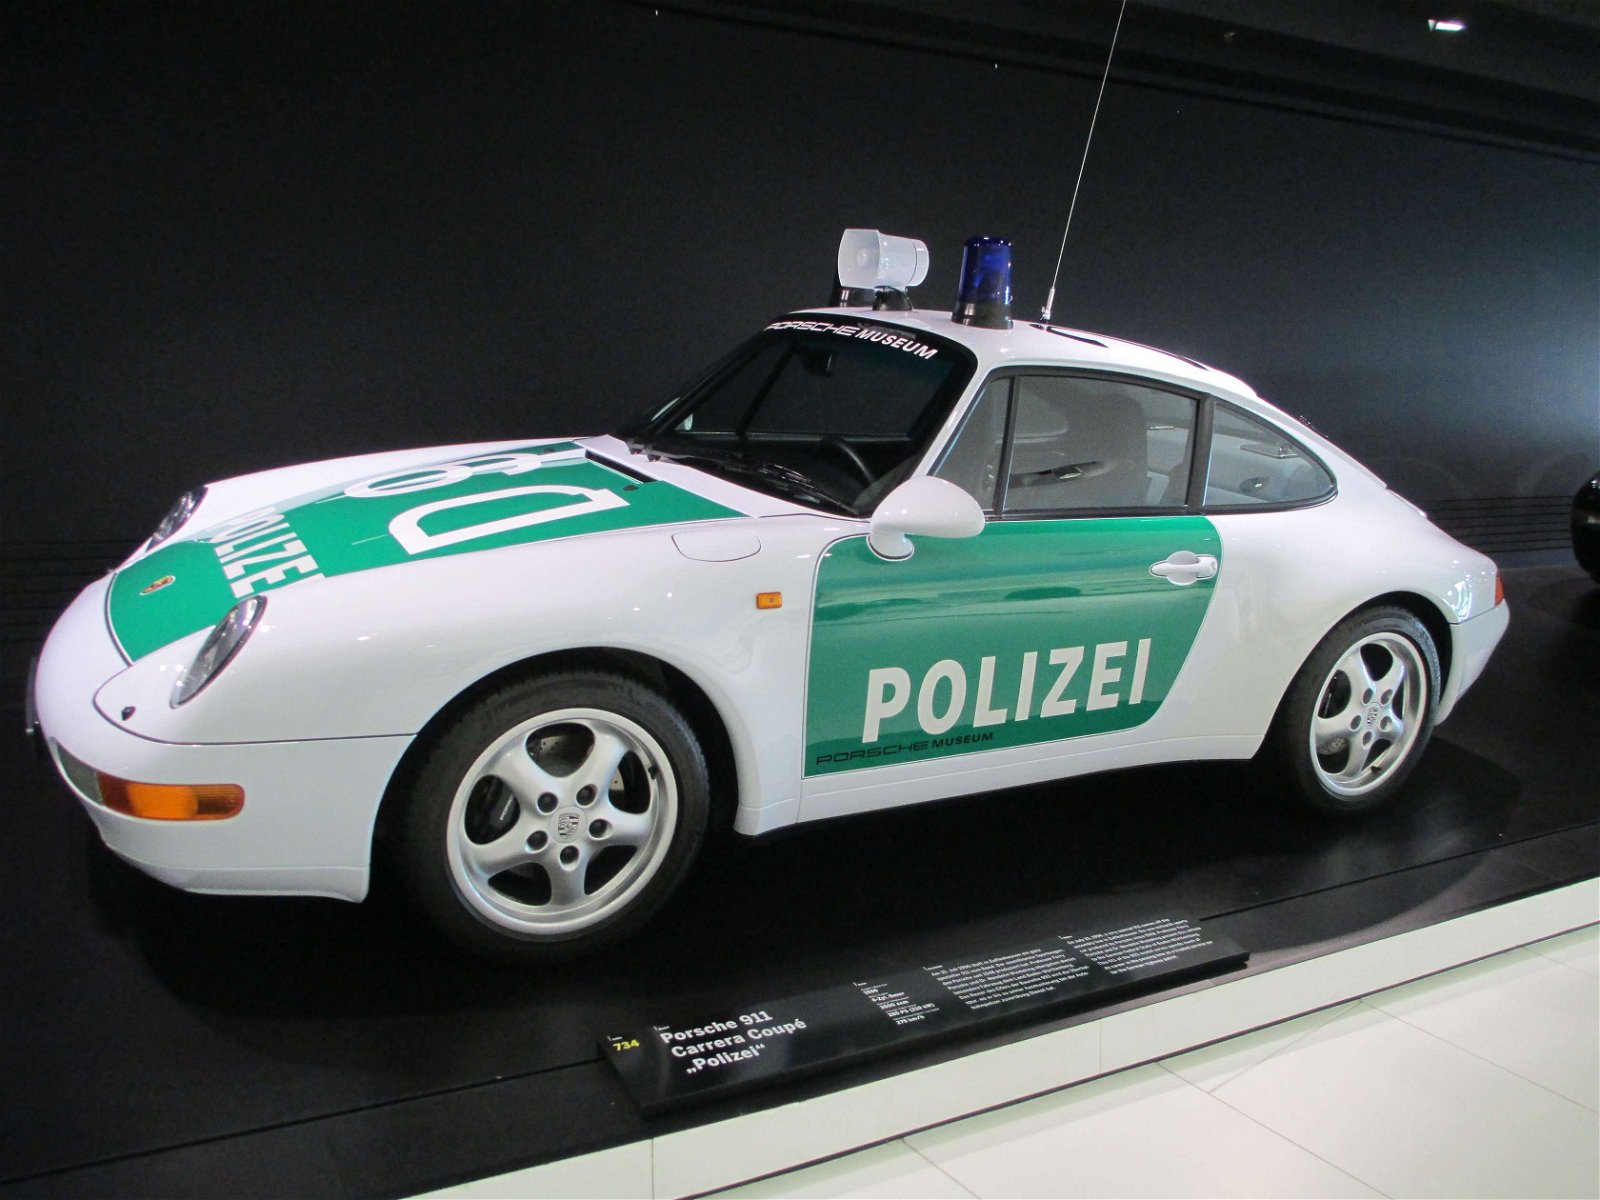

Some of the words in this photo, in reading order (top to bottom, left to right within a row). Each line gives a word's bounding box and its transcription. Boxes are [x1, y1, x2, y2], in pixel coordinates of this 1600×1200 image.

[763, 321, 861, 336] PORSCHE
[855, 329, 939, 360] MUSEUM
[862, 638, 1152, 744] POLIZEI
[815, 740, 929, 765] PORSCHE
[932, 732, 994, 749] MUSEUM
[660, 1018, 738, 1044] Porsche
[739, 1010, 773, 1026] 911
[671, 1033, 746, 1058] Carrera
[747, 1018, 807, 1040] Coupé
[612, 1039, 640, 1052] 734
[686, 1043, 766, 1075] „Polizei“
